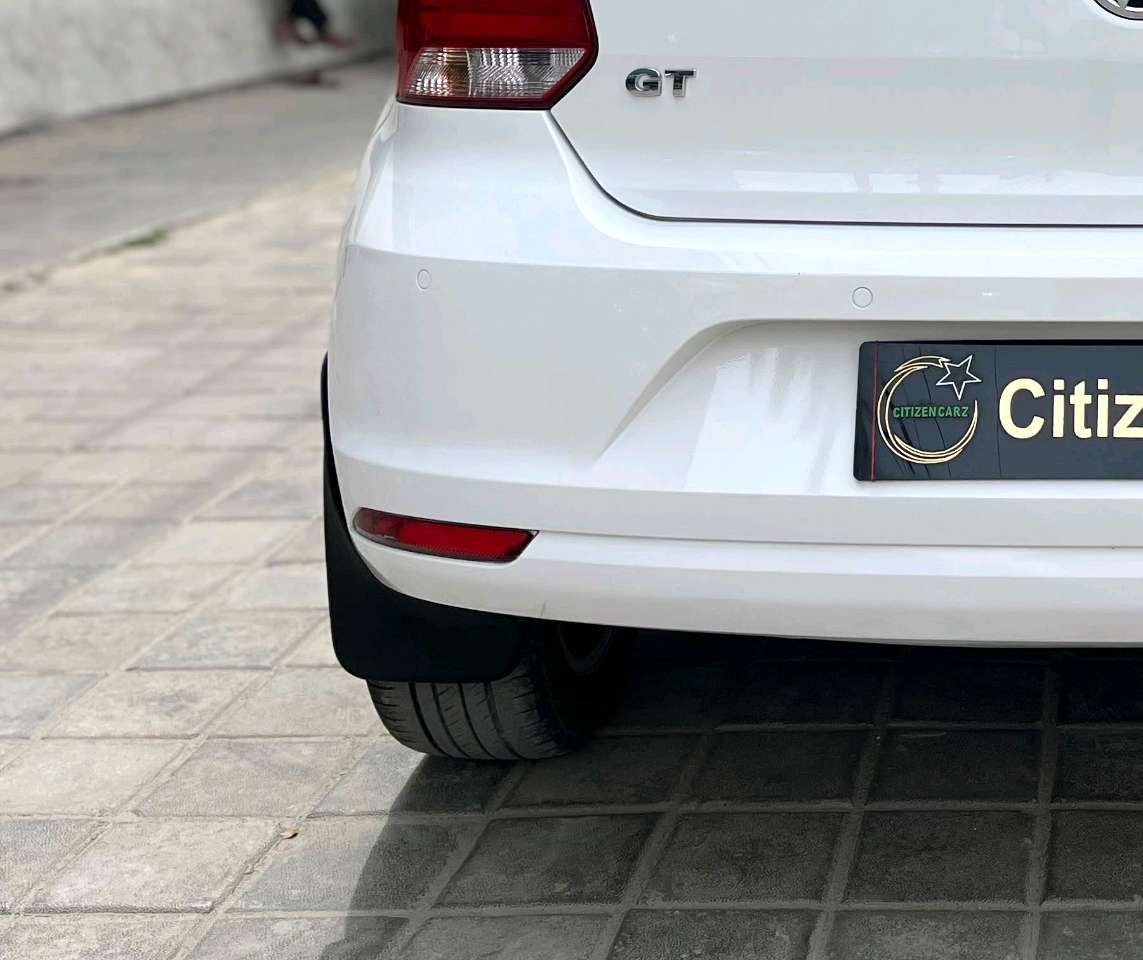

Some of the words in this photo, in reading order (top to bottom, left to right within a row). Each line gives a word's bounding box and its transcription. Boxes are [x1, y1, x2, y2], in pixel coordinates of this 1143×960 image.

[625, 67, 697, 98] GT
[893, 406, 938, 418] CITIZEN
[938, 406, 969, 417] CARZ
